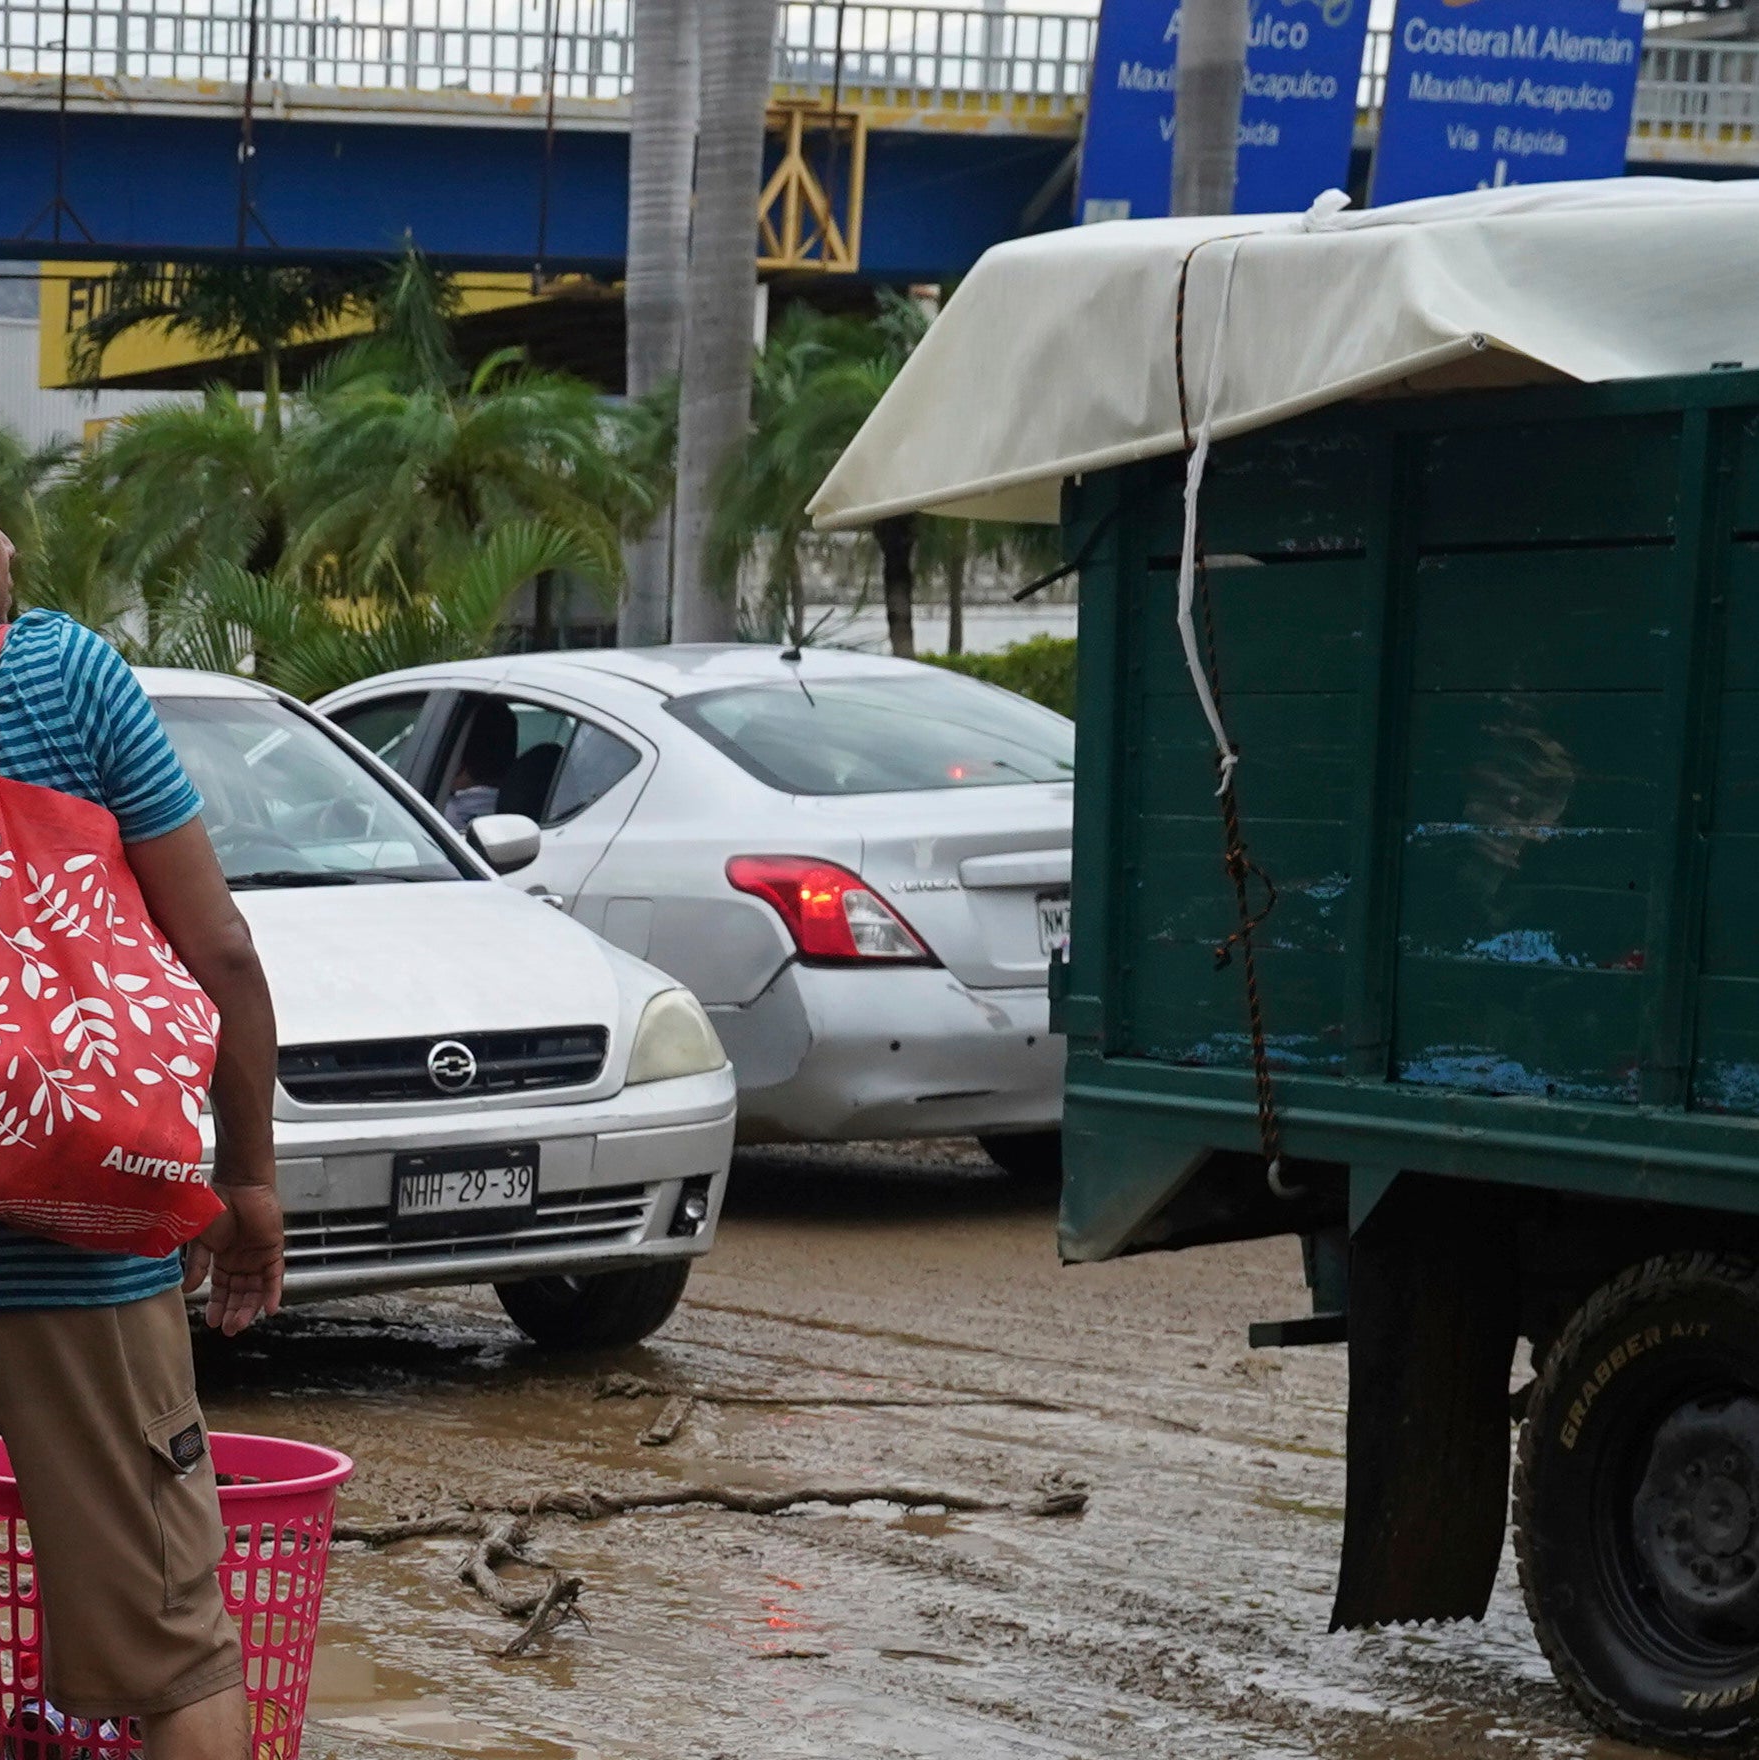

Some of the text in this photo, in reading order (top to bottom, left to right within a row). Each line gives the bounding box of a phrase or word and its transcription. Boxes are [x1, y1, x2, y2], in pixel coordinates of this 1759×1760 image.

[1163, 9, 1309, 49] Aulco
[1404, 17, 1510, 58] Costera
[1514, 77, 1614, 114] Acapulco
[100, 1145, 203, 1184] Aurrera
[1559, 1326, 1663, 1451] GRABBER
